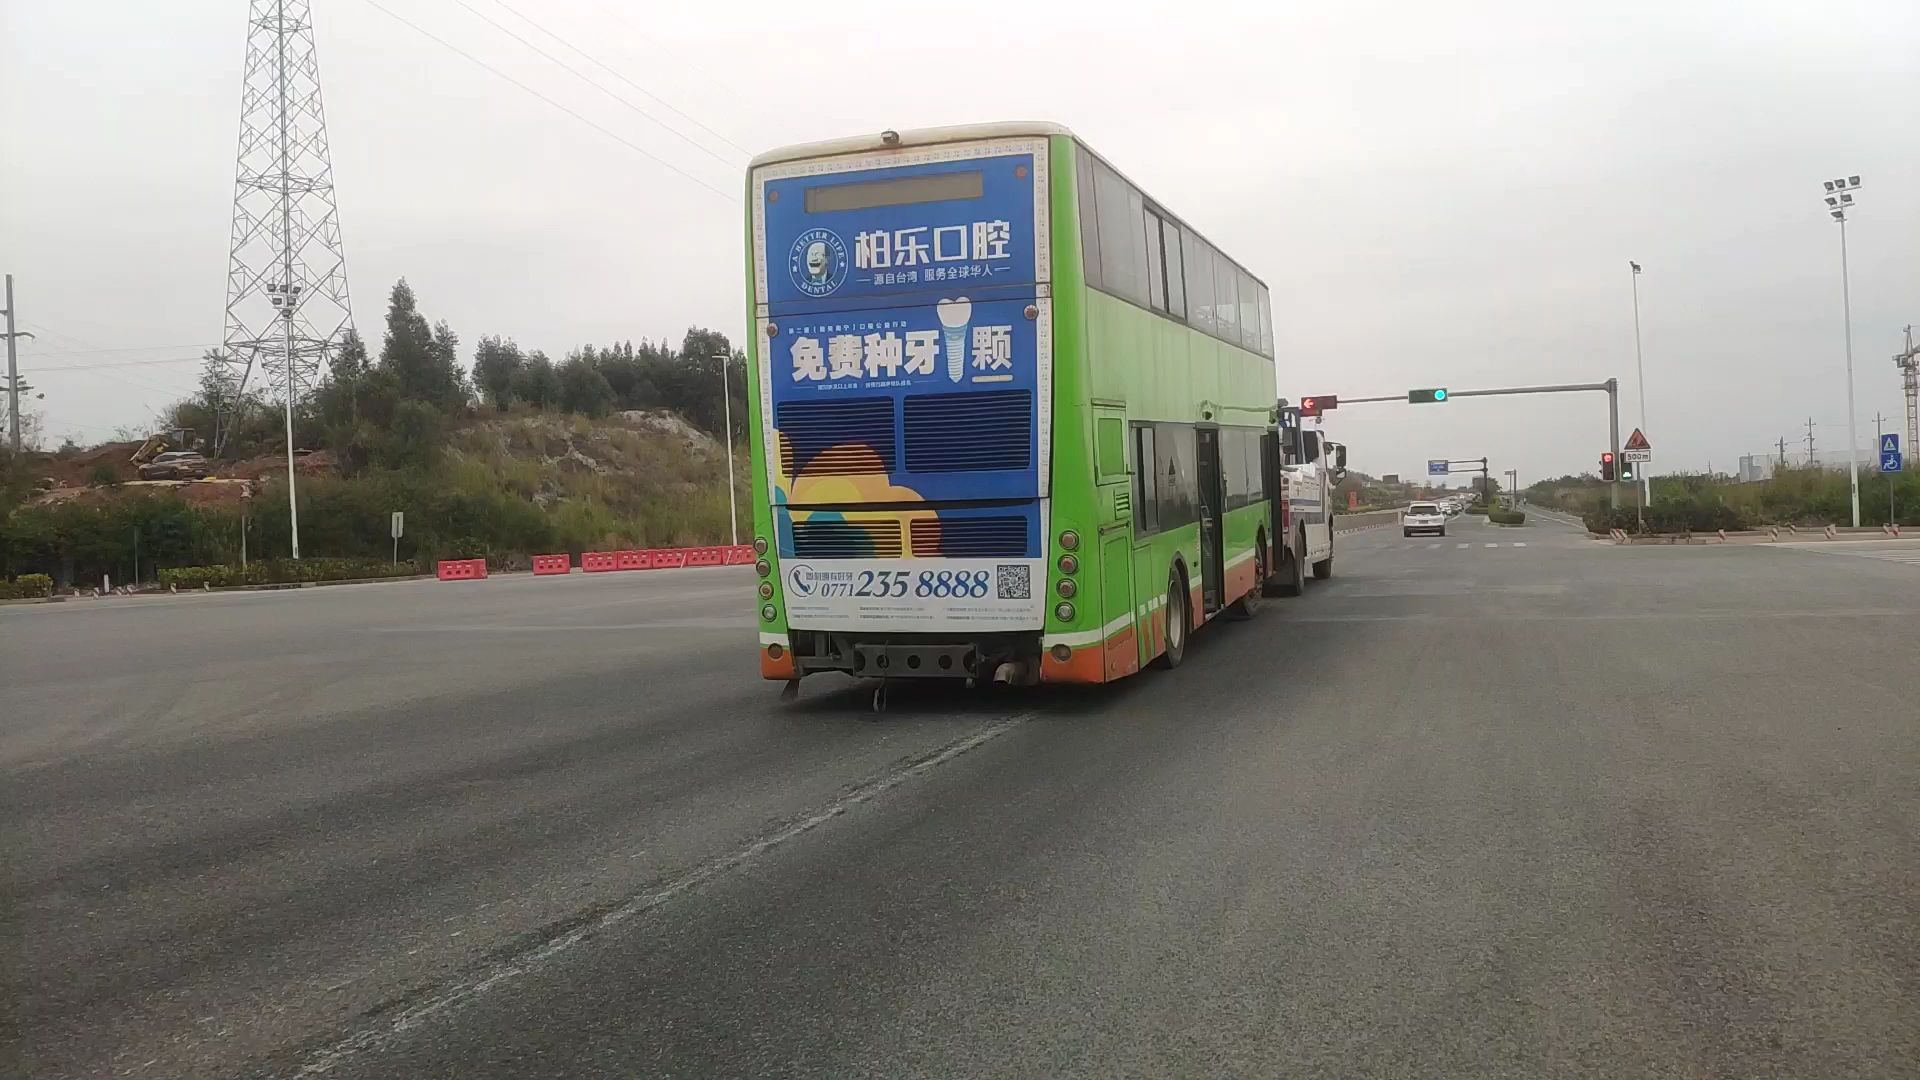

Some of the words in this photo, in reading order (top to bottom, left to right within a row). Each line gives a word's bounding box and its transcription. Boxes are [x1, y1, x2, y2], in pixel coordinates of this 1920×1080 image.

[795, 231, 828, 252] BETTER
[829, 236, 845, 259] LIFE
[855, 219, 1011, 269] 柏乐口腔
[801, 280, 838, 294] DENTAL
[873, 271, 918, 286] 源自台湾
[924, 263, 993, 282] 服务全球华人
[789, 330, 940, 383] 免费种牙
[971, 324, 1013, 371] 颗
[821, 583, 855, 598] 0771
[855, 570, 912, 599] 235
[914, 570, 990, 599] 8888
